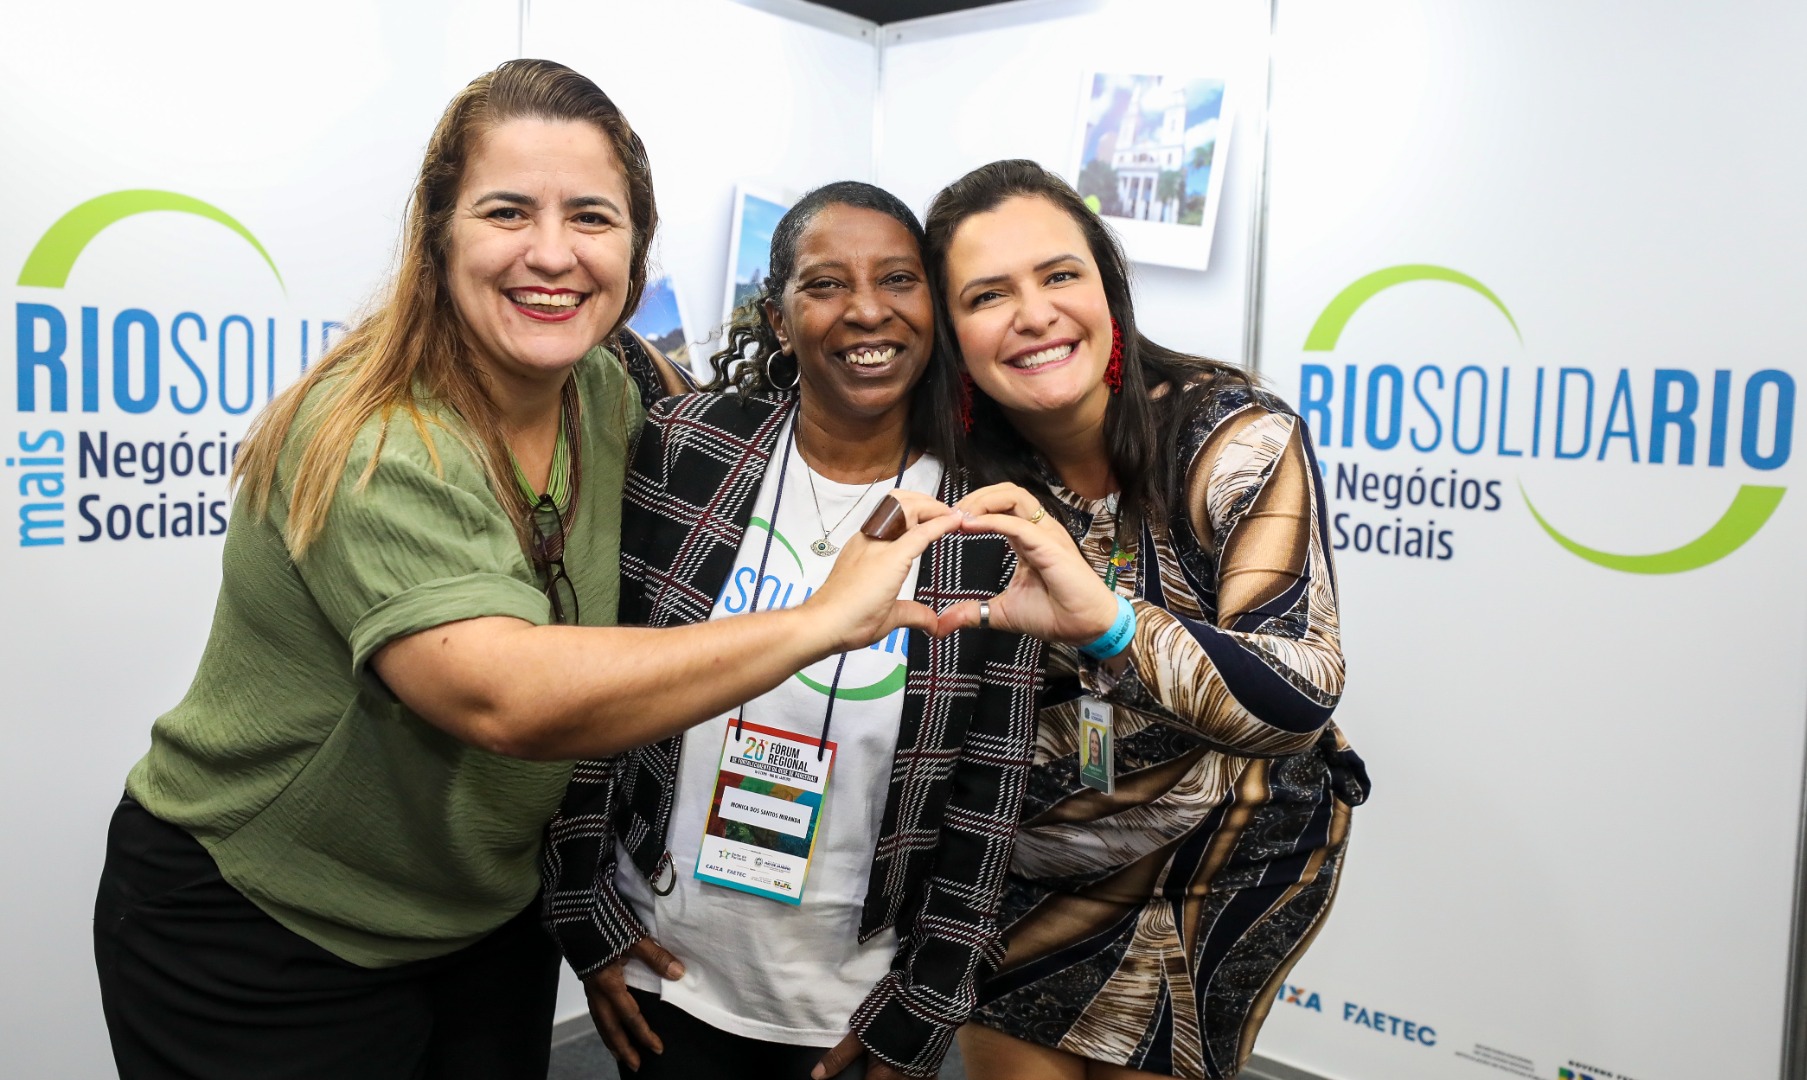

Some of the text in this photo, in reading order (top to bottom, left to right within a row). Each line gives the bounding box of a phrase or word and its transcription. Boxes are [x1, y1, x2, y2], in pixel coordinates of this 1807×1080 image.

[16, 303, 349, 415] RIOSOLI
[1300, 363, 1796, 471] RIOSOLIDARIO
[6, 430, 65, 547] mais
[1336, 462, 1502, 512] Negócios
[79, 491, 228, 545] Sociais
[1332, 512, 1454, 561] Sociais
[767, 753, 809, 773] REGIONAL
[769, 742, 801, 759] FÓRUM
[760, 808, 778, 819] SANTOS
[778, 813, 801, 824] MIRANDA
[705, 863, 723, 872] CAIXA
[1278, 983, 1322, 1013] IXA
[1343, 1002, 1437, 1047] FAETEC
